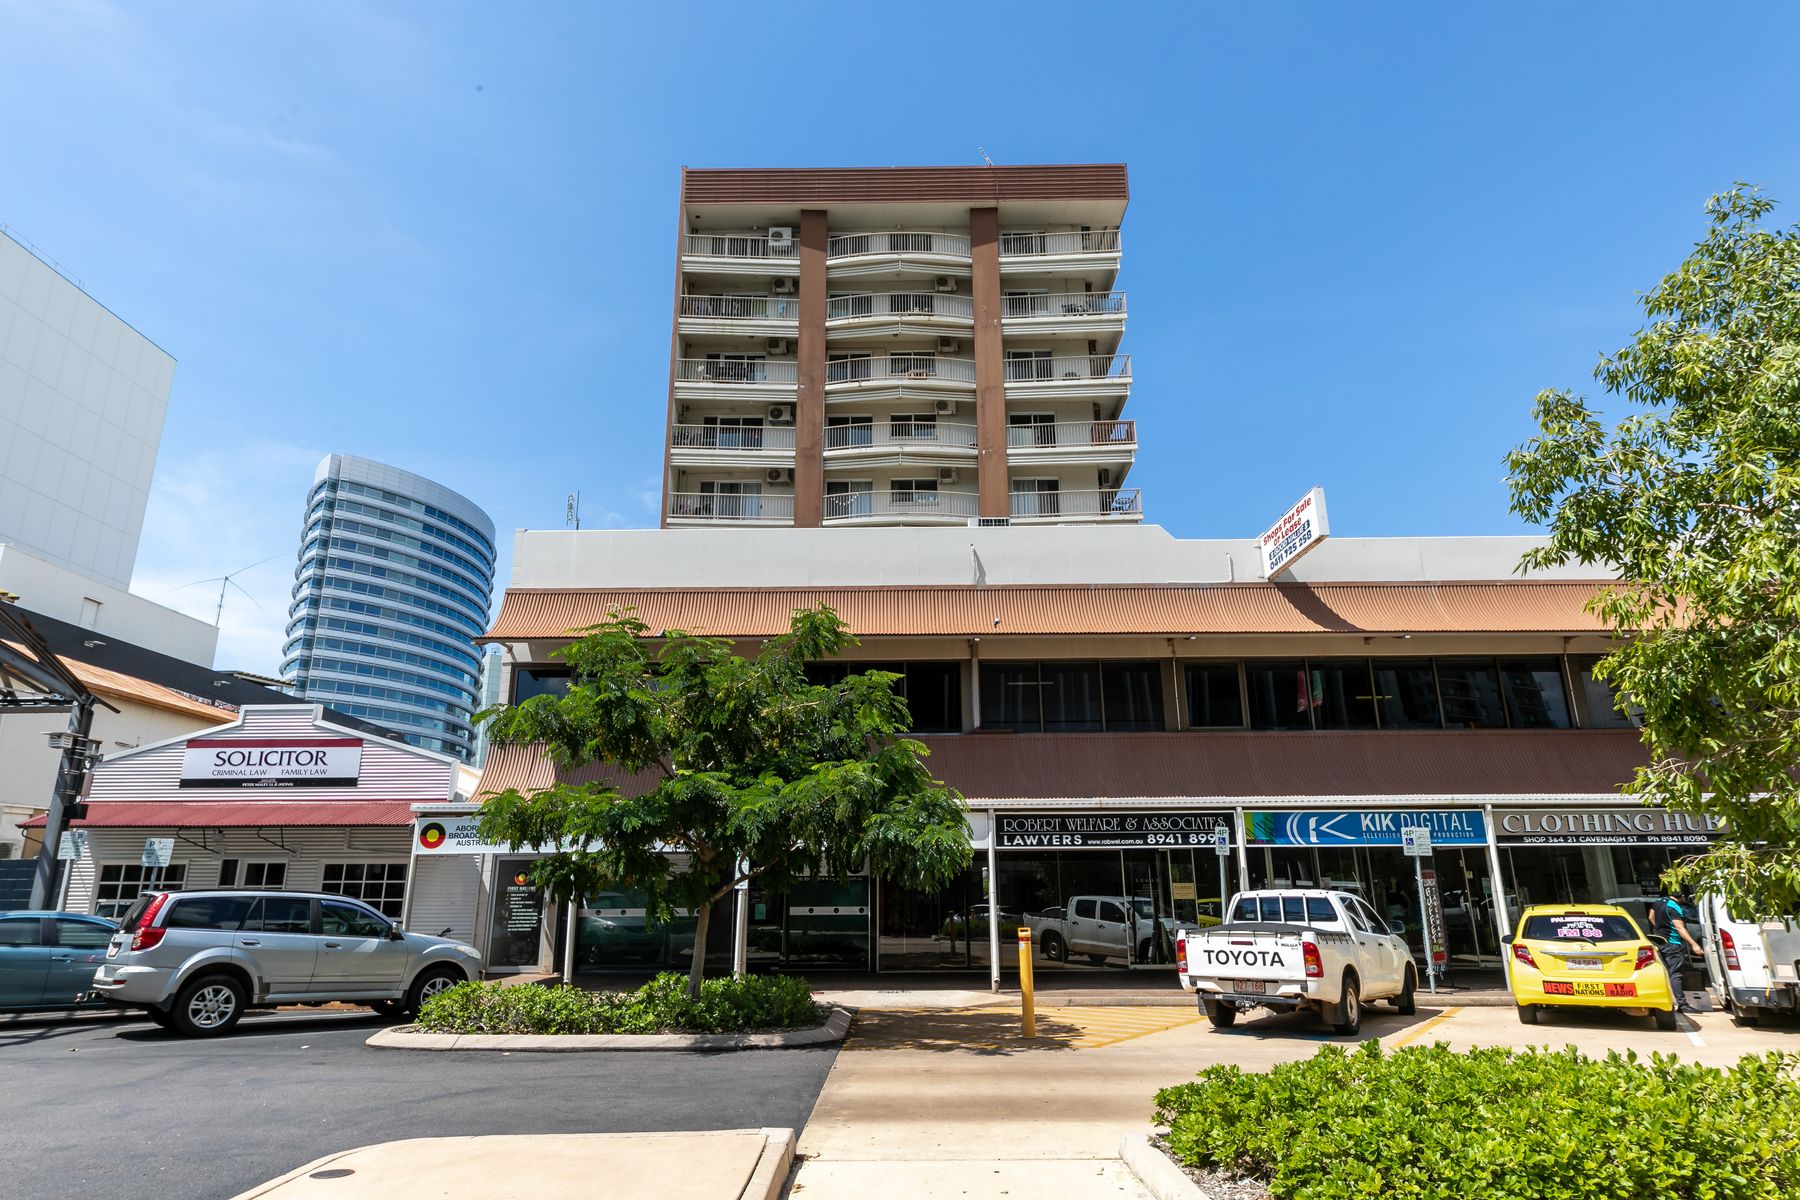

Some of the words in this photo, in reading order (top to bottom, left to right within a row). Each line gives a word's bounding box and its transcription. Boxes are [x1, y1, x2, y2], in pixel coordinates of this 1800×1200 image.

[1263, 523, 1282, 546] Shops
[1283, 512, 1295, 528] For
[1296, 497, 1312, 516] Sale
[1281, 517, 1302, 540] Lease
[1270, 555, 1284, 570] 0411
[1284, 543, 1298, 558] 725
[1298, 530, 1312, 547] 258
[214, 750, 328, 767] SOLICITOR
[1004, 818, 1061, 832] ROBERT
[1065, 818, 1120, 831] WELFARE
[1125, 817, 1138, 830] &
[1142, 816, 1226, 830] ASSOCIATES
[1360, 813, 1396, 831] KIK
[1400, 812, 1472, 831] DIGITAL
[1502, 814, 1655, 833] CLOTHING
[1662, 813, 1720, 832] HUB
[1004, 834, 1082, 846] LAWYERS
[1147, 834, 1182, 844] 8941
[1188, 834, 1216, 844] 899
[1558, 929, 1580, 937] FM
[1203, 950, 1285, 967] TOYOTA
[1544, 982, 1573, 994] NEWS
